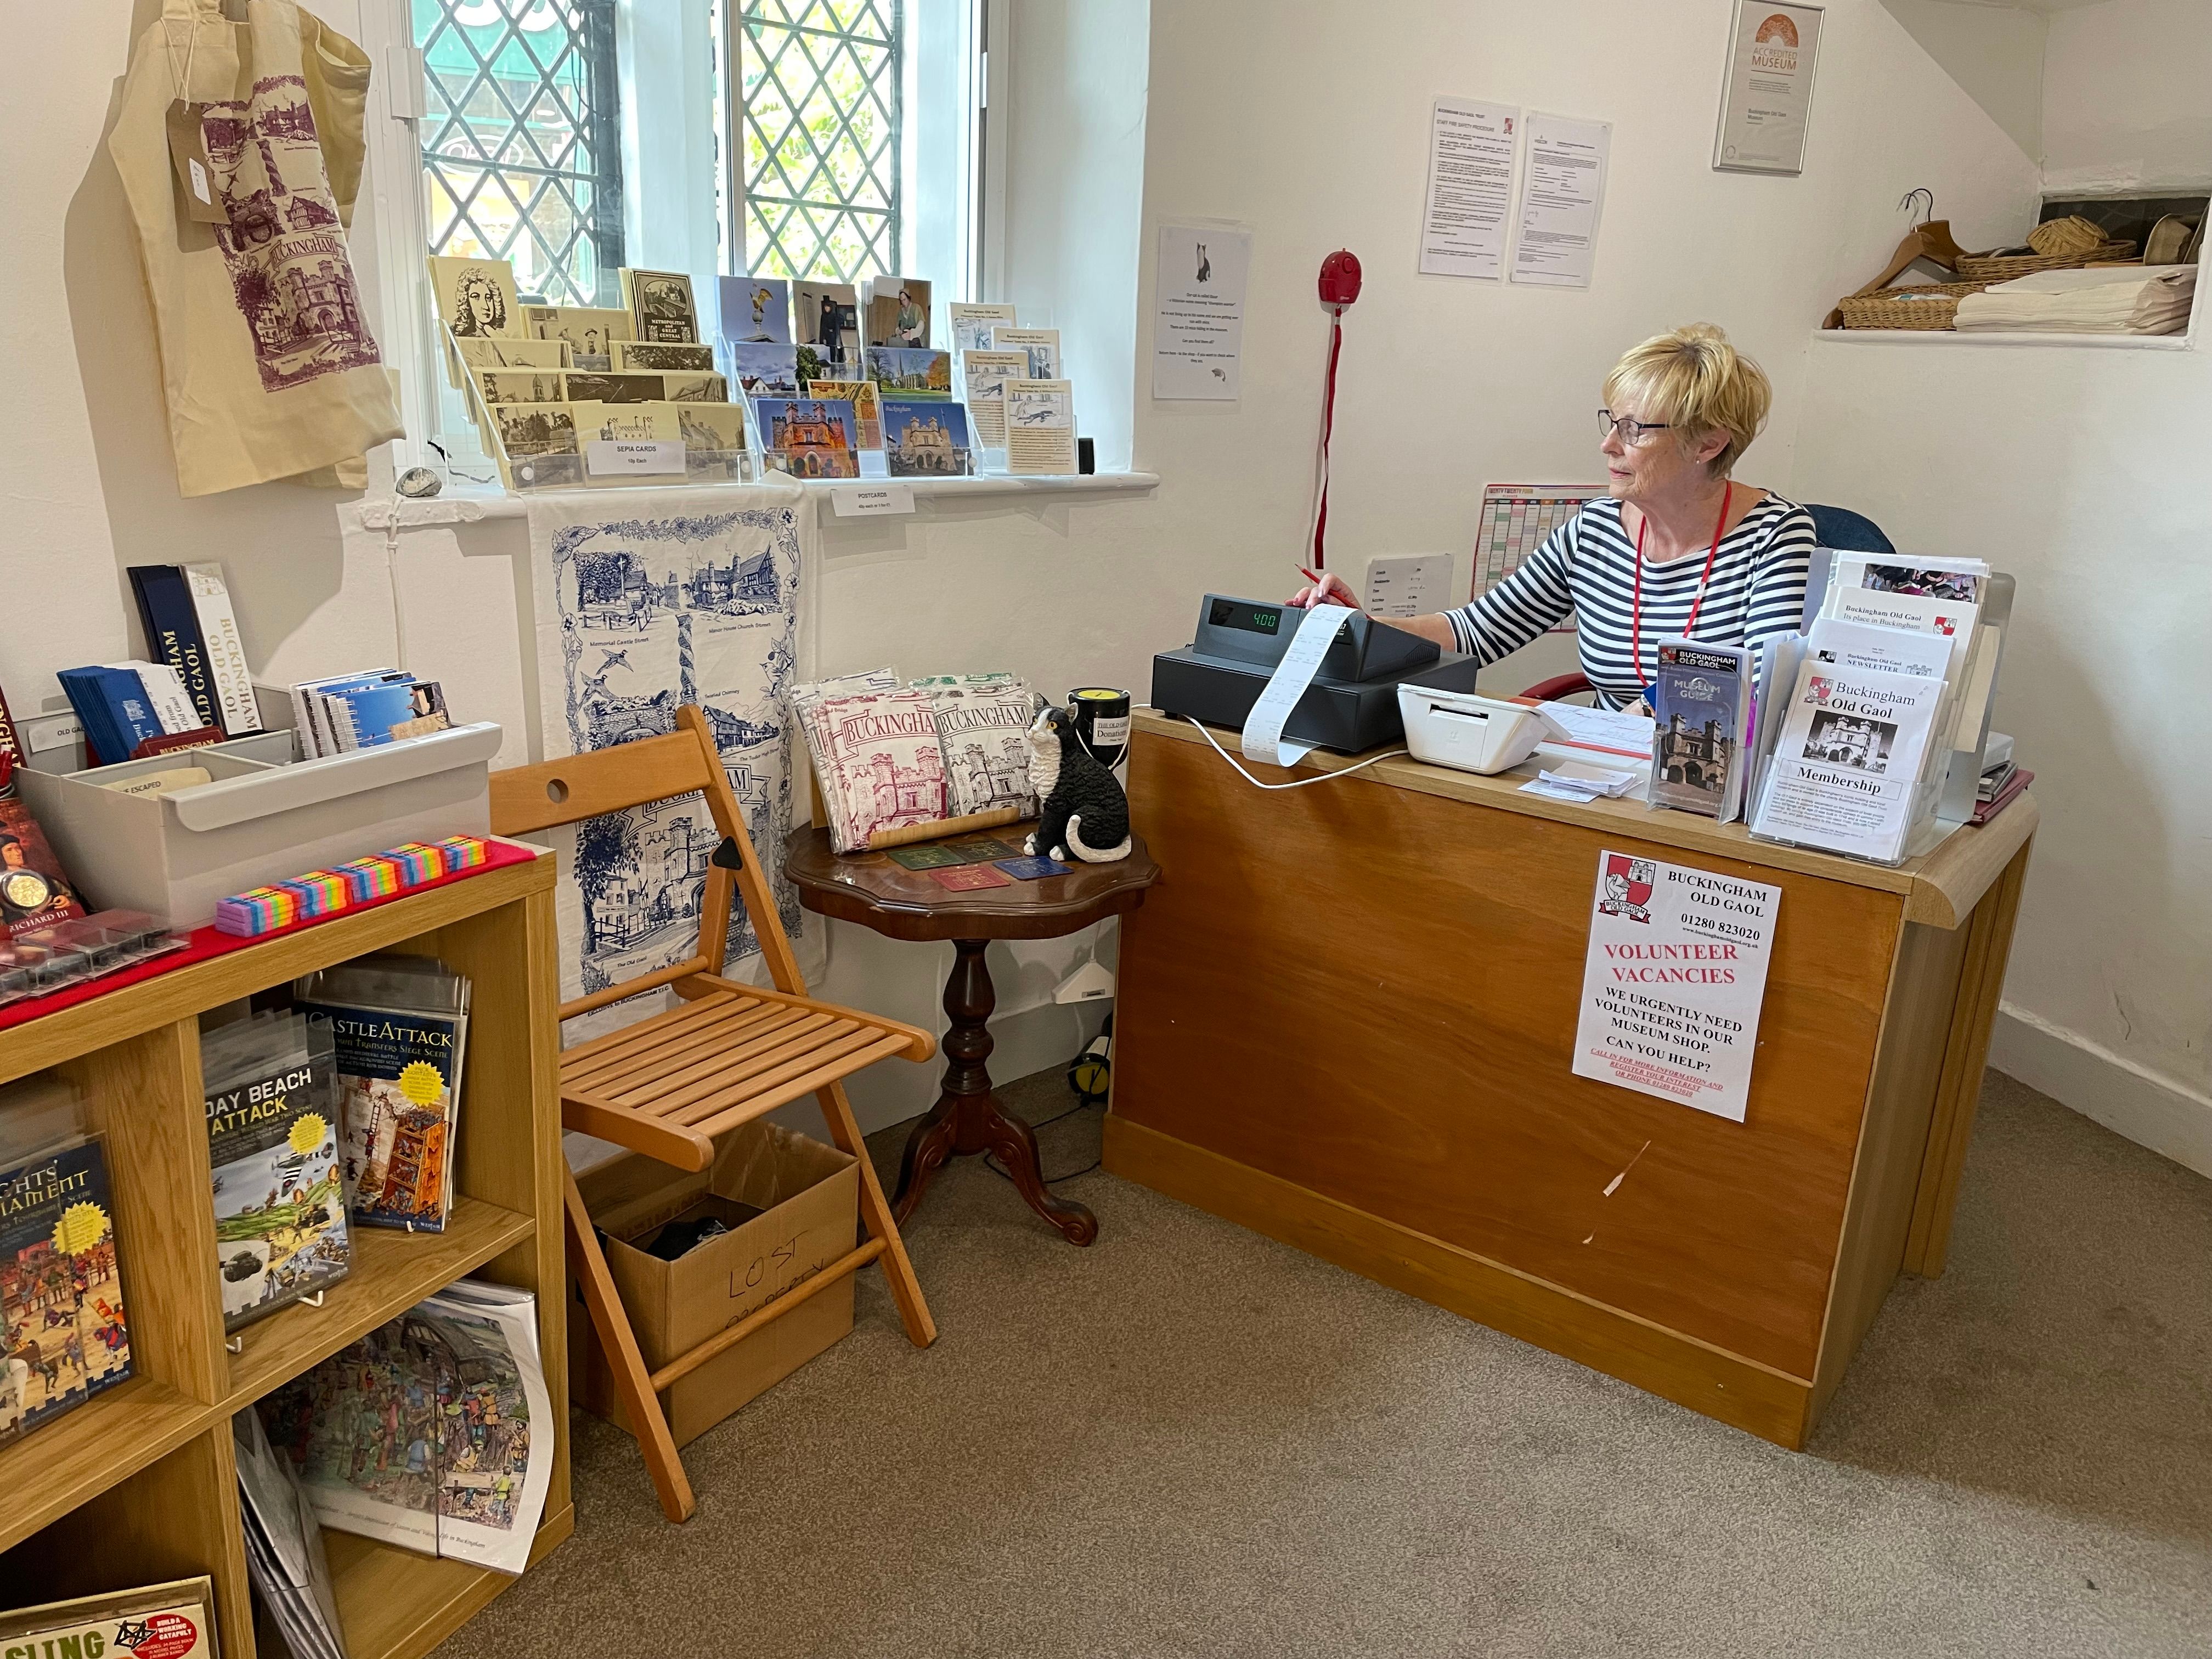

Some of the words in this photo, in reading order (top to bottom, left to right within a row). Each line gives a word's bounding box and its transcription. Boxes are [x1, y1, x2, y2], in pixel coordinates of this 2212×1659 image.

[1752, 55, 1796, 70] MUSEUM
[1753, 48, 1798, 60] ACCREDITED
[272, 237, 336, 262] BUCKINGHAM
[1846, 605, 1888, 617] Buckingham
[737, 623, 754, 631] Church
[1880, 618, 1920, 630] Buckingham
[590, 639, 616, 648] Memorial
[616, 638, 634, 646] Castle
[634, 636, 649, 645] Street
[1679, 651, 1736, 665] BUCKINGHAM
[1697, 661, 1720, 669] GAOL
[1847, 653, 1878, 662] Buckingham
[1847, 659, 1898, 673] NEWSLETTER
[184, 643, 205, 691] GAOL
[219, 618, 258, 729] BUCKINGHAM
[208, 634, 227, 669] OLD
[219, 673, 239, 719] GAOL
[721, 688, 740, 697] Chimney
[1674, 680, 1720, 693] MUSEUM
[1836, 681, 1915, 706] Buckingham
[169, 696, 182, 713] Gaol
[196, 694, 213, 727] OLD
[1831, 698, 1856, 712] Old
[1860, 703, 1893, 719] Gaol
[178, 714, 189, 726] Old
[940, 705, 1028, 732] BUCKINGHAM
[57, 728, 70, 736] OLD
[845, 713, 937, 743] BUCKINGHA
[1097, 729, 1126, 737] Donations
[159, 738, 216, 755] BUCKINGHAM
[131, 781, 161, 794] ESCAPED
[1797, 767, 1881, 795] Membership
[1668, 871, 1768, 902] BUCKINGHAM
[1605, 901, 1645, 915] BUCKINGHAM
[1624, 907, 1639, 916] GAOL
[1690, 891, 1719, 907] OLD
[1723, 899, 1764, 917] GAOL
[9, 913, 55, 932] RICHARD
[56, 910, 69, 918] III
[1681, 913, 1715, 930] 01280
[1718, 922, 1760, 941] 823020
[1603, 944, 1739, 960] VOLUNTEER
[626, 958, 635, 967] Old
[635, 955, 647, 964] Gaol
[1611, 967, 1736, 984] VACANCIES
[620, 989, 658, 1005] BUCKINGHAM
[1606, 986, 1626, 1001] WE
[1630, 993, 1702, 1021] URGENTLY
[1705, 1014, 1742, 1032] NEED
[1595, 998, 1682, 1030] VOLUNTEERS
[1686, 1023, 1700, 1035] IN
[1703, 1029, 1733, 1045] OUR
[1611, 1017, 1669, 1042] MUSEUM
[1673, 1034, 1711, 1053] SHOP.
[355, 1038, 398, 1053] TRANSFERS
[400, 1044, 421, 1056] SIEGE
[424, 1048, 448, 1059] SCENE
[1606, 1036, 1634, 1051] CAN
[1637, 1043, 1665, 1059] YOU
[1668, 1053, 1711, 1073] HELP?
[1590, 1047, 1609, 1058] CALL
[1618, 1055, 1633, 1065] FOR
[1634, 1059, 1655, 1070] MORE
[1656, 1065, 1707, 1086] INFORMATION
[1708, 1081, 1724, 1092] AND
[1610, 1061, 1644, 1075] REGISTER
[1645, 1070, 1664, 1081] YOUR
[1666, 1076, 1701, 1092] INTEREST
[1615, 1070, 1626, 1078] OR
[1627, 1072, 1651, 1085] PHONE
[249, 1067, 312, 1104] BEACH
[212, 1095, 289, 1136] ATTACK
[729, 1229, 808, 1299] LOST
[156, 1618, 176, 1627] BUILD
[157, 1623, 187, 1633] WORKING
[159, 1629, 191, 1640] CATAPULT
